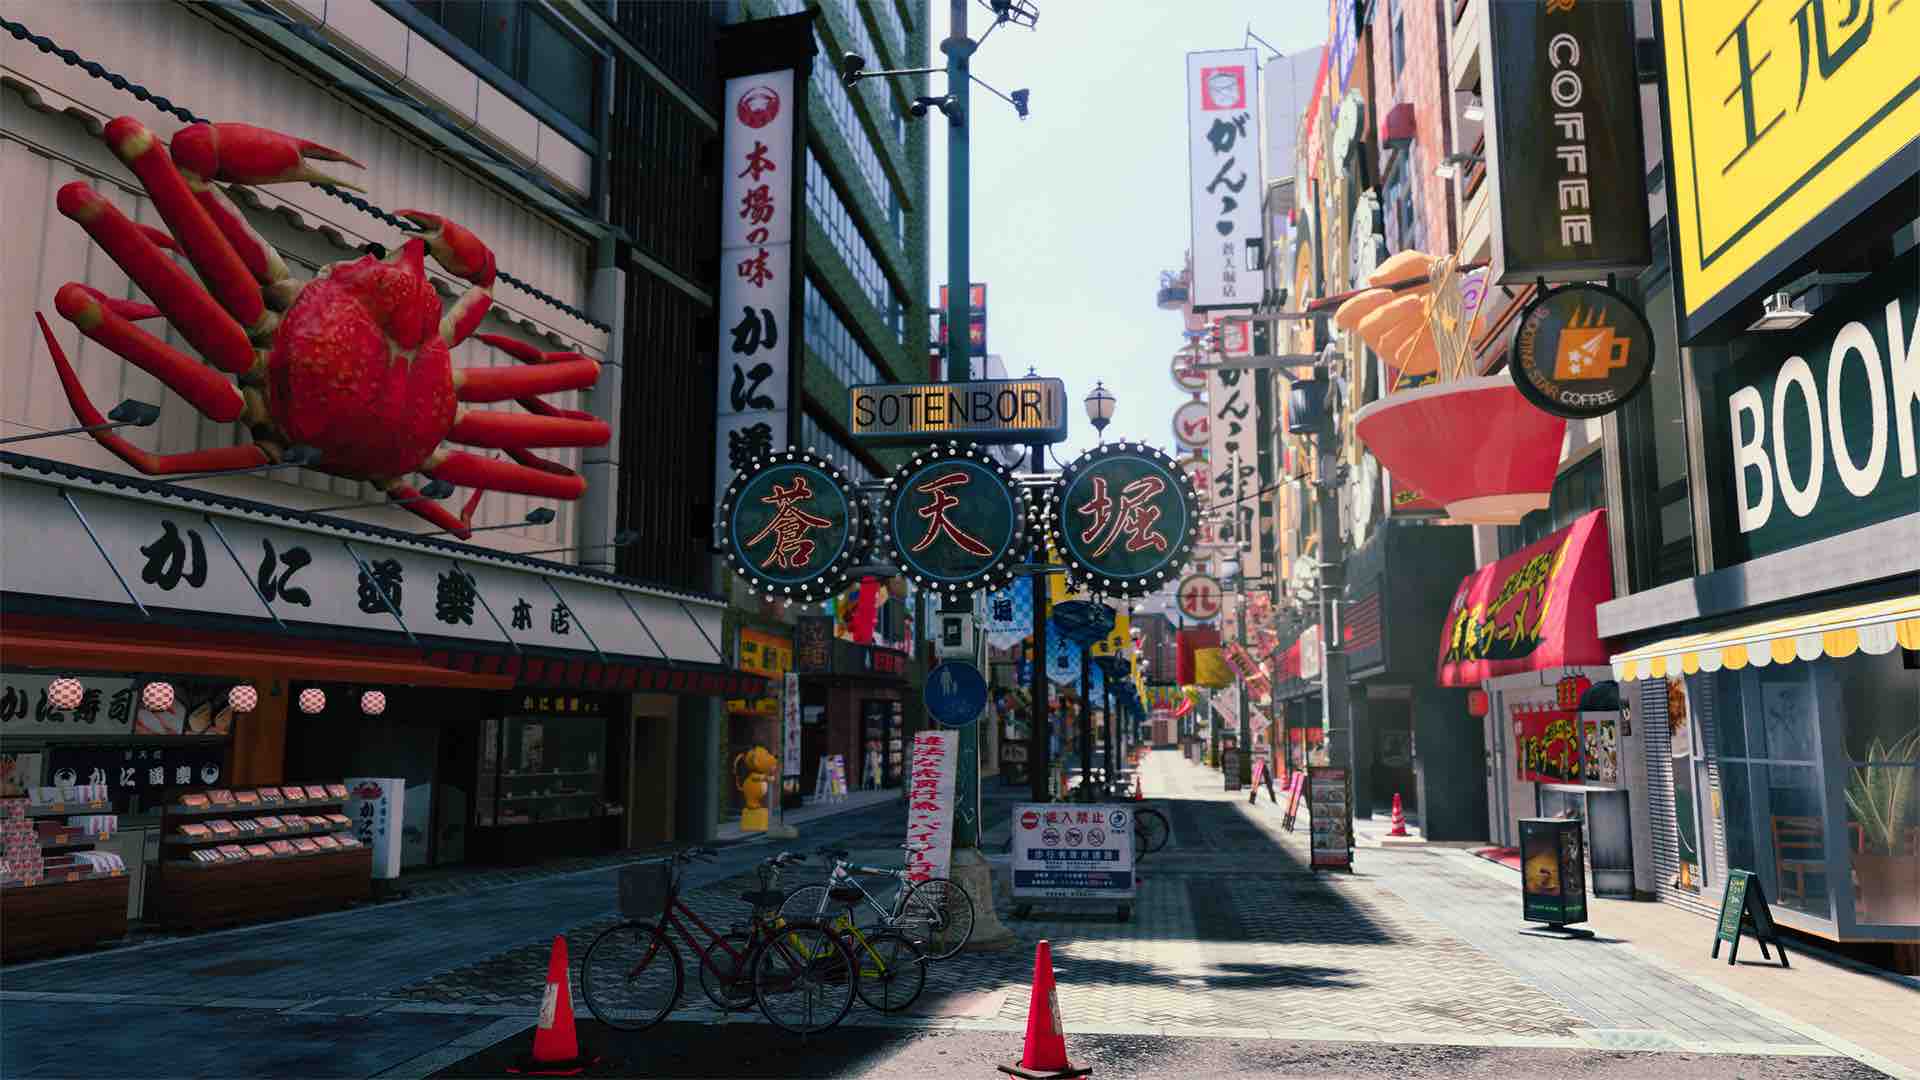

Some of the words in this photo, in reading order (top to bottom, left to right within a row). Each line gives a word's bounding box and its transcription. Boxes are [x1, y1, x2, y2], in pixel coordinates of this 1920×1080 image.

[1549, 33, 1592, 246] COFFEE
[736, 141, 776, 289] 本場の味
[856, 388, 1055, 428] SOTENBORI
[1560, 390, 1618, 406] COFFEE
[140, 519, 476, 626] かに道楽
[511, 598, 571, 635] 本店
